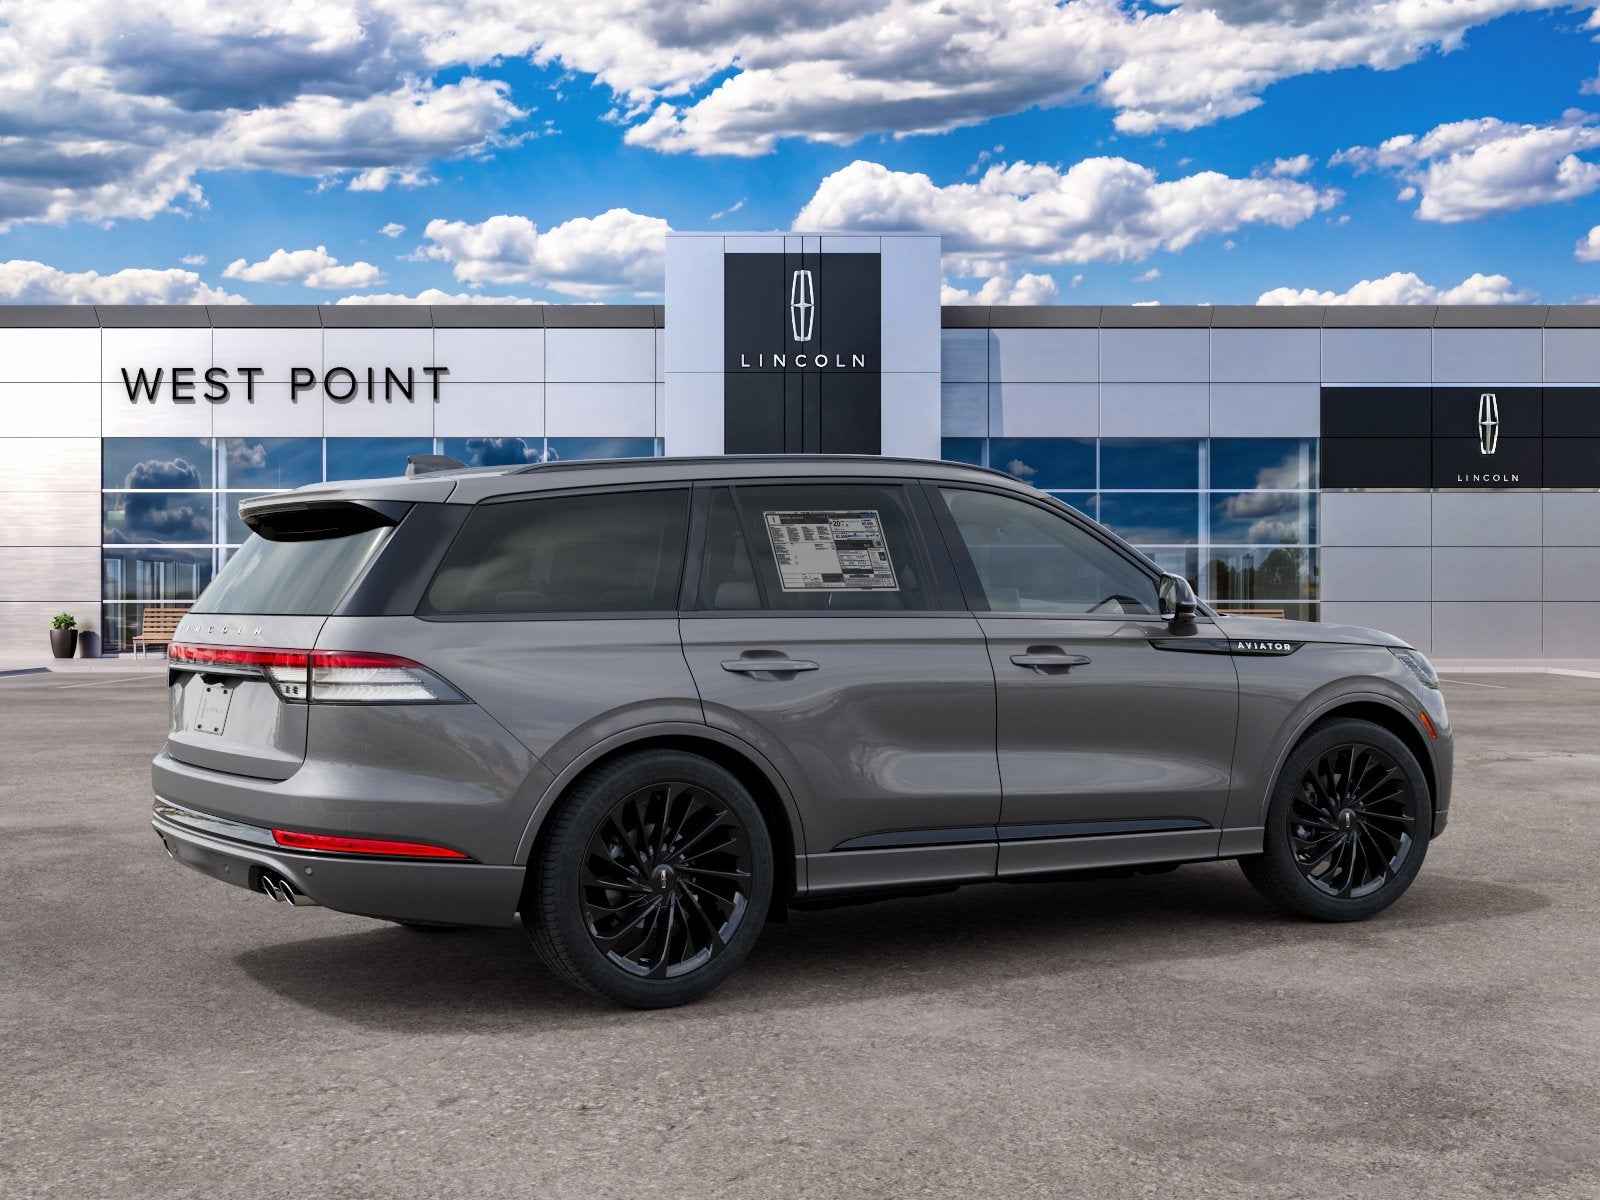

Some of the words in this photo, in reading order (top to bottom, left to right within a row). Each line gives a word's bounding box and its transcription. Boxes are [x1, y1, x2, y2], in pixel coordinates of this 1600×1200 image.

[741, 353, 865, 368] LINCOLN
[120, 366, 264, 403] WEST
[290, 366, 450, 403] POINT
[1457, 474, 1519, 482] LINCOLN
[1237, 641, 1291, 651] AVIATOR
